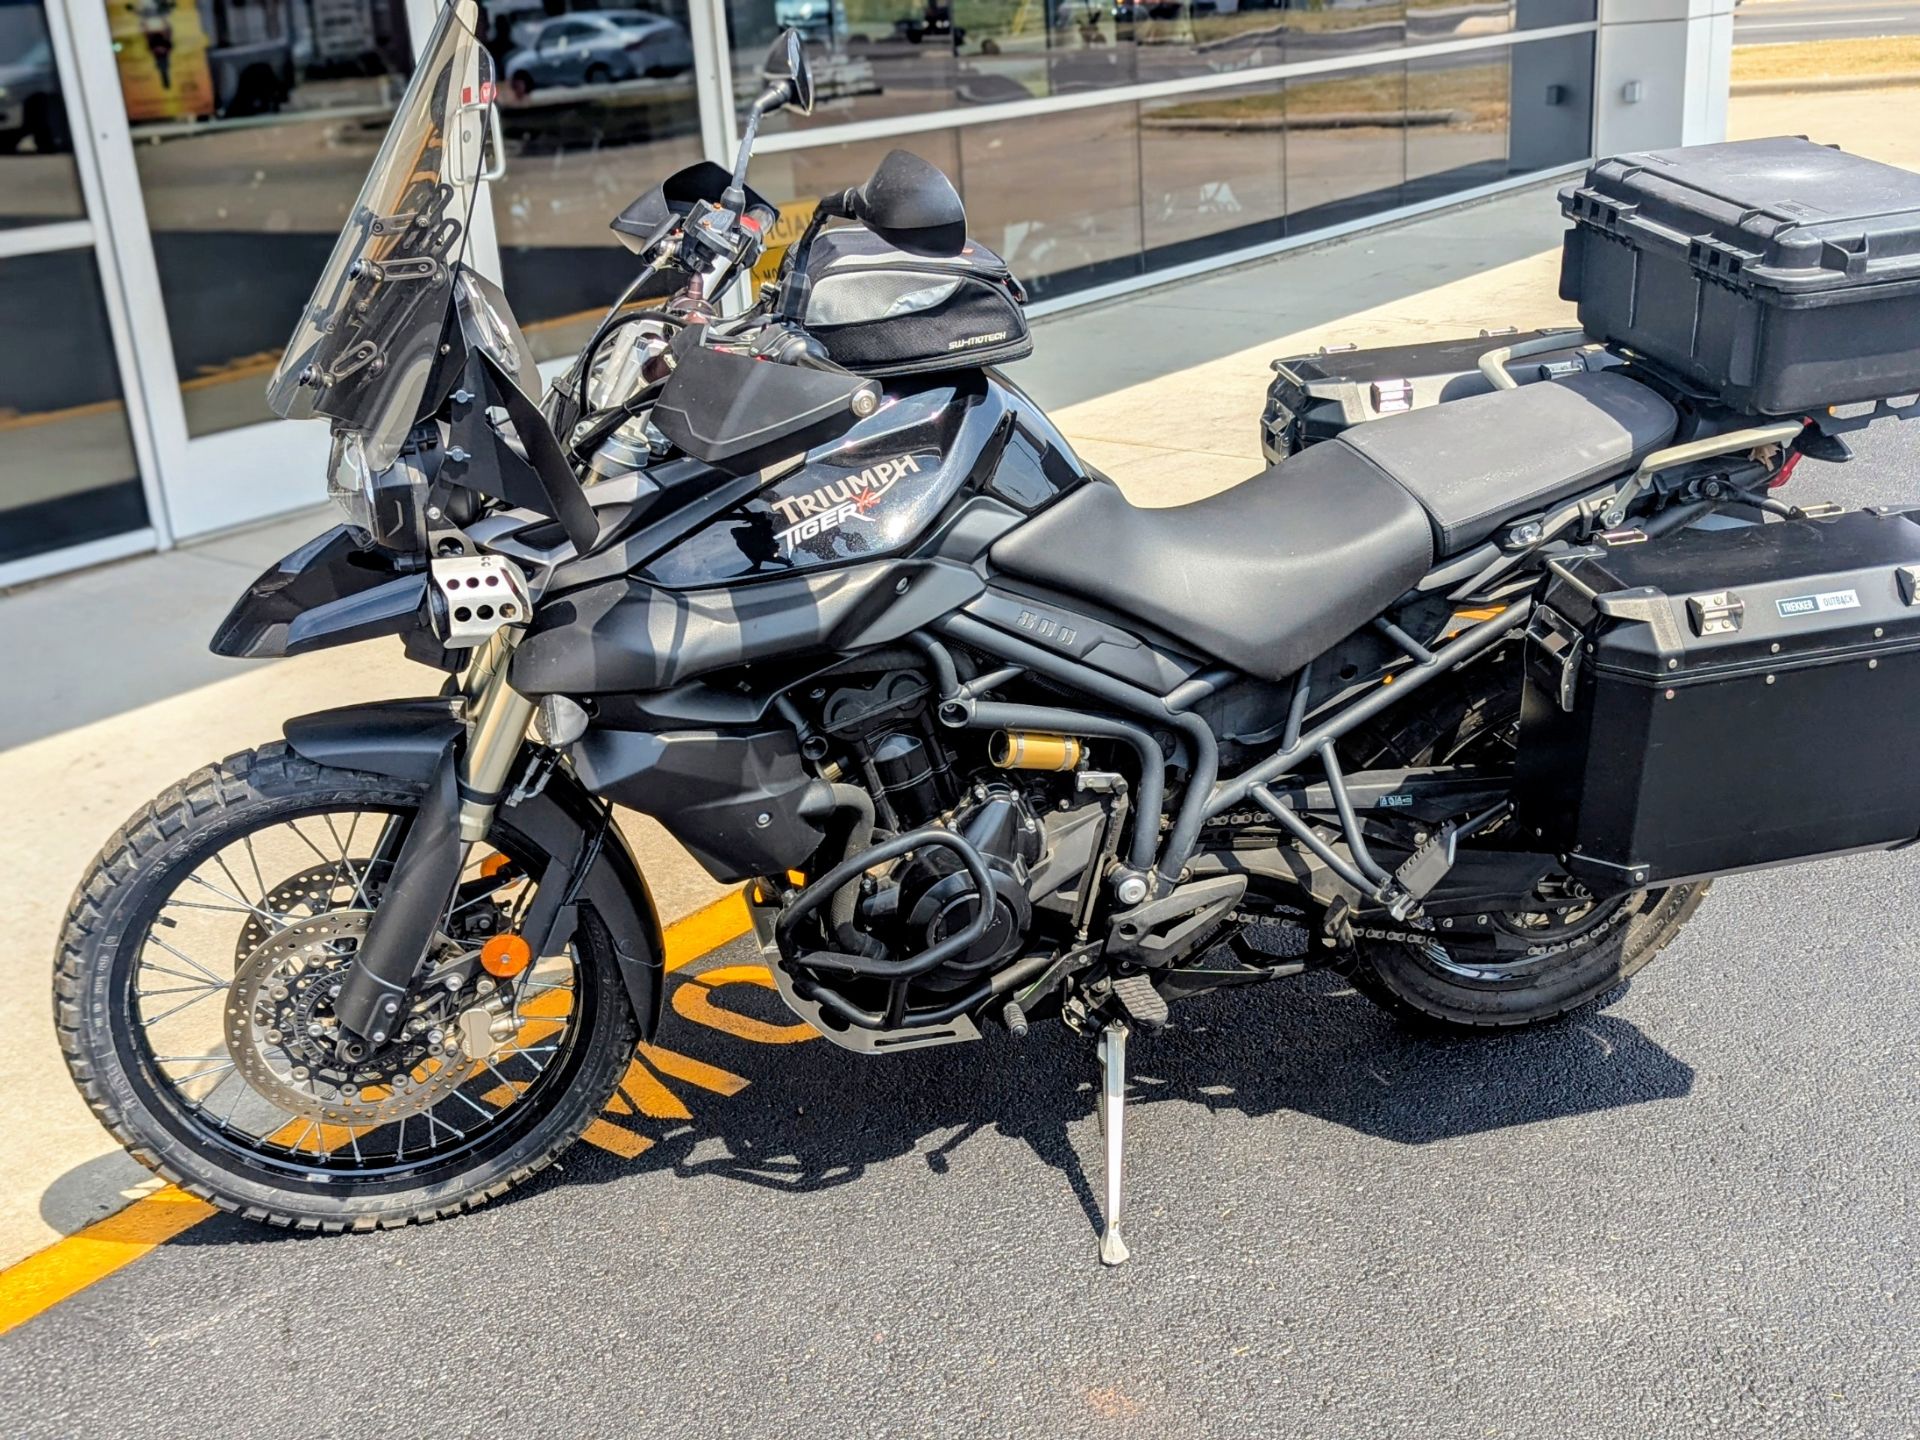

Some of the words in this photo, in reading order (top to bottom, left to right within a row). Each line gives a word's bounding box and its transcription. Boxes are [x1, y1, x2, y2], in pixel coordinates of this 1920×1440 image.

[948, 331, 1007, 350] SW-MOTECH
[771, 455, 921, 524] TRIUMPH
[773, 501, 876, 559] TIGER
[1781, 599, 1815, 613] TREKKER
[1823, 594, 1855, 607] OUTBACK
[1016, 609, 1077, 646] 800
